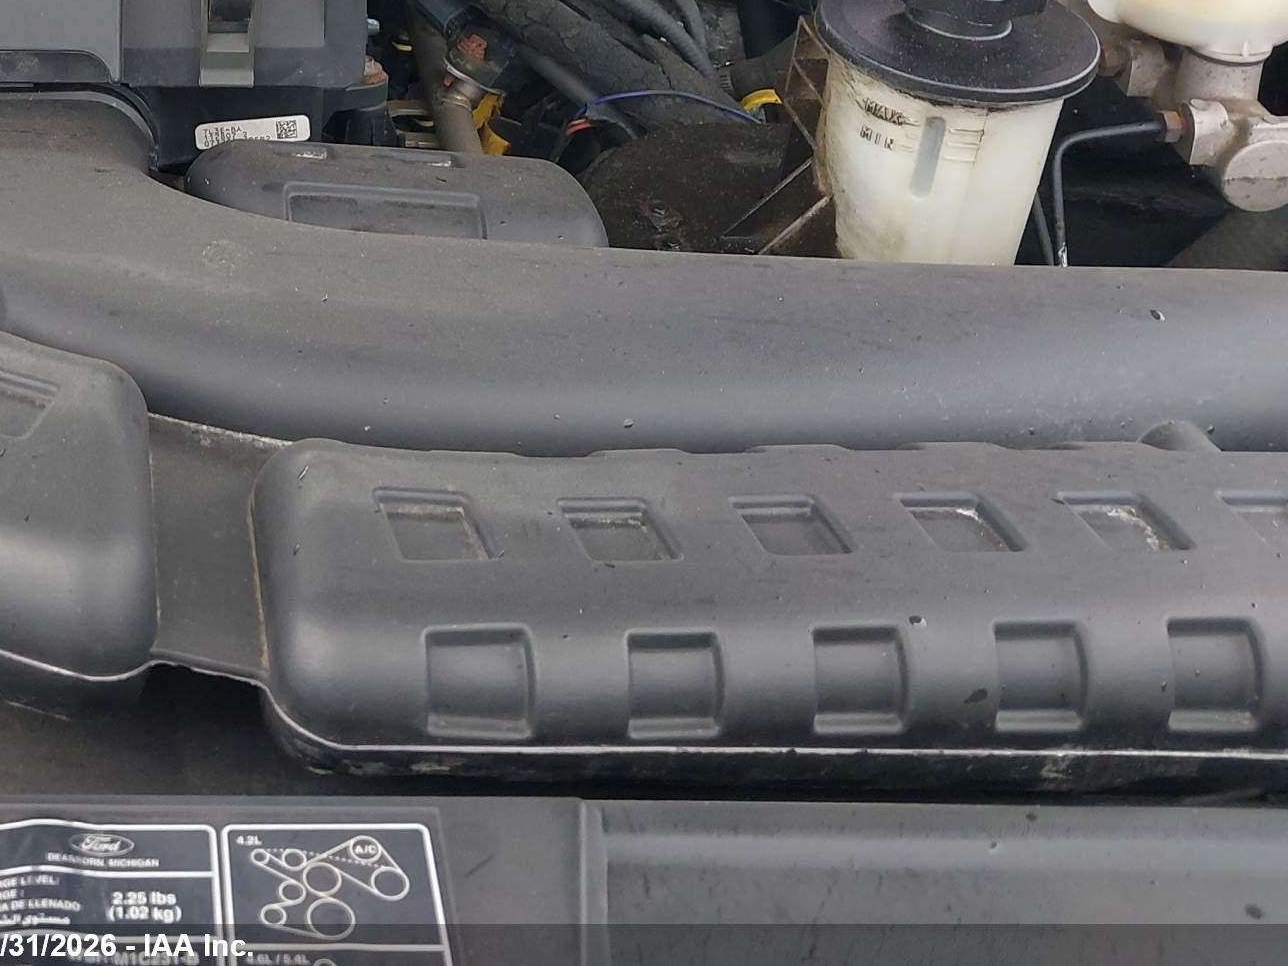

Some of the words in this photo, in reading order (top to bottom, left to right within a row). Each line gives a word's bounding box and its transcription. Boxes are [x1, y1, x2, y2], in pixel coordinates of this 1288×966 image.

[81, 833, 122, 852] Ford
[236, 836, 261, 845] 4.2L
[355, 845, 377, 854] A/C
[108, 857, 160, 867] MICHIGAN
[112, 891, 147, 905] 2.25
[149, 891, 177, 905] lbs
[106, 905, 149, 922] (1.02
[152, 905, 182, 924] kg)
